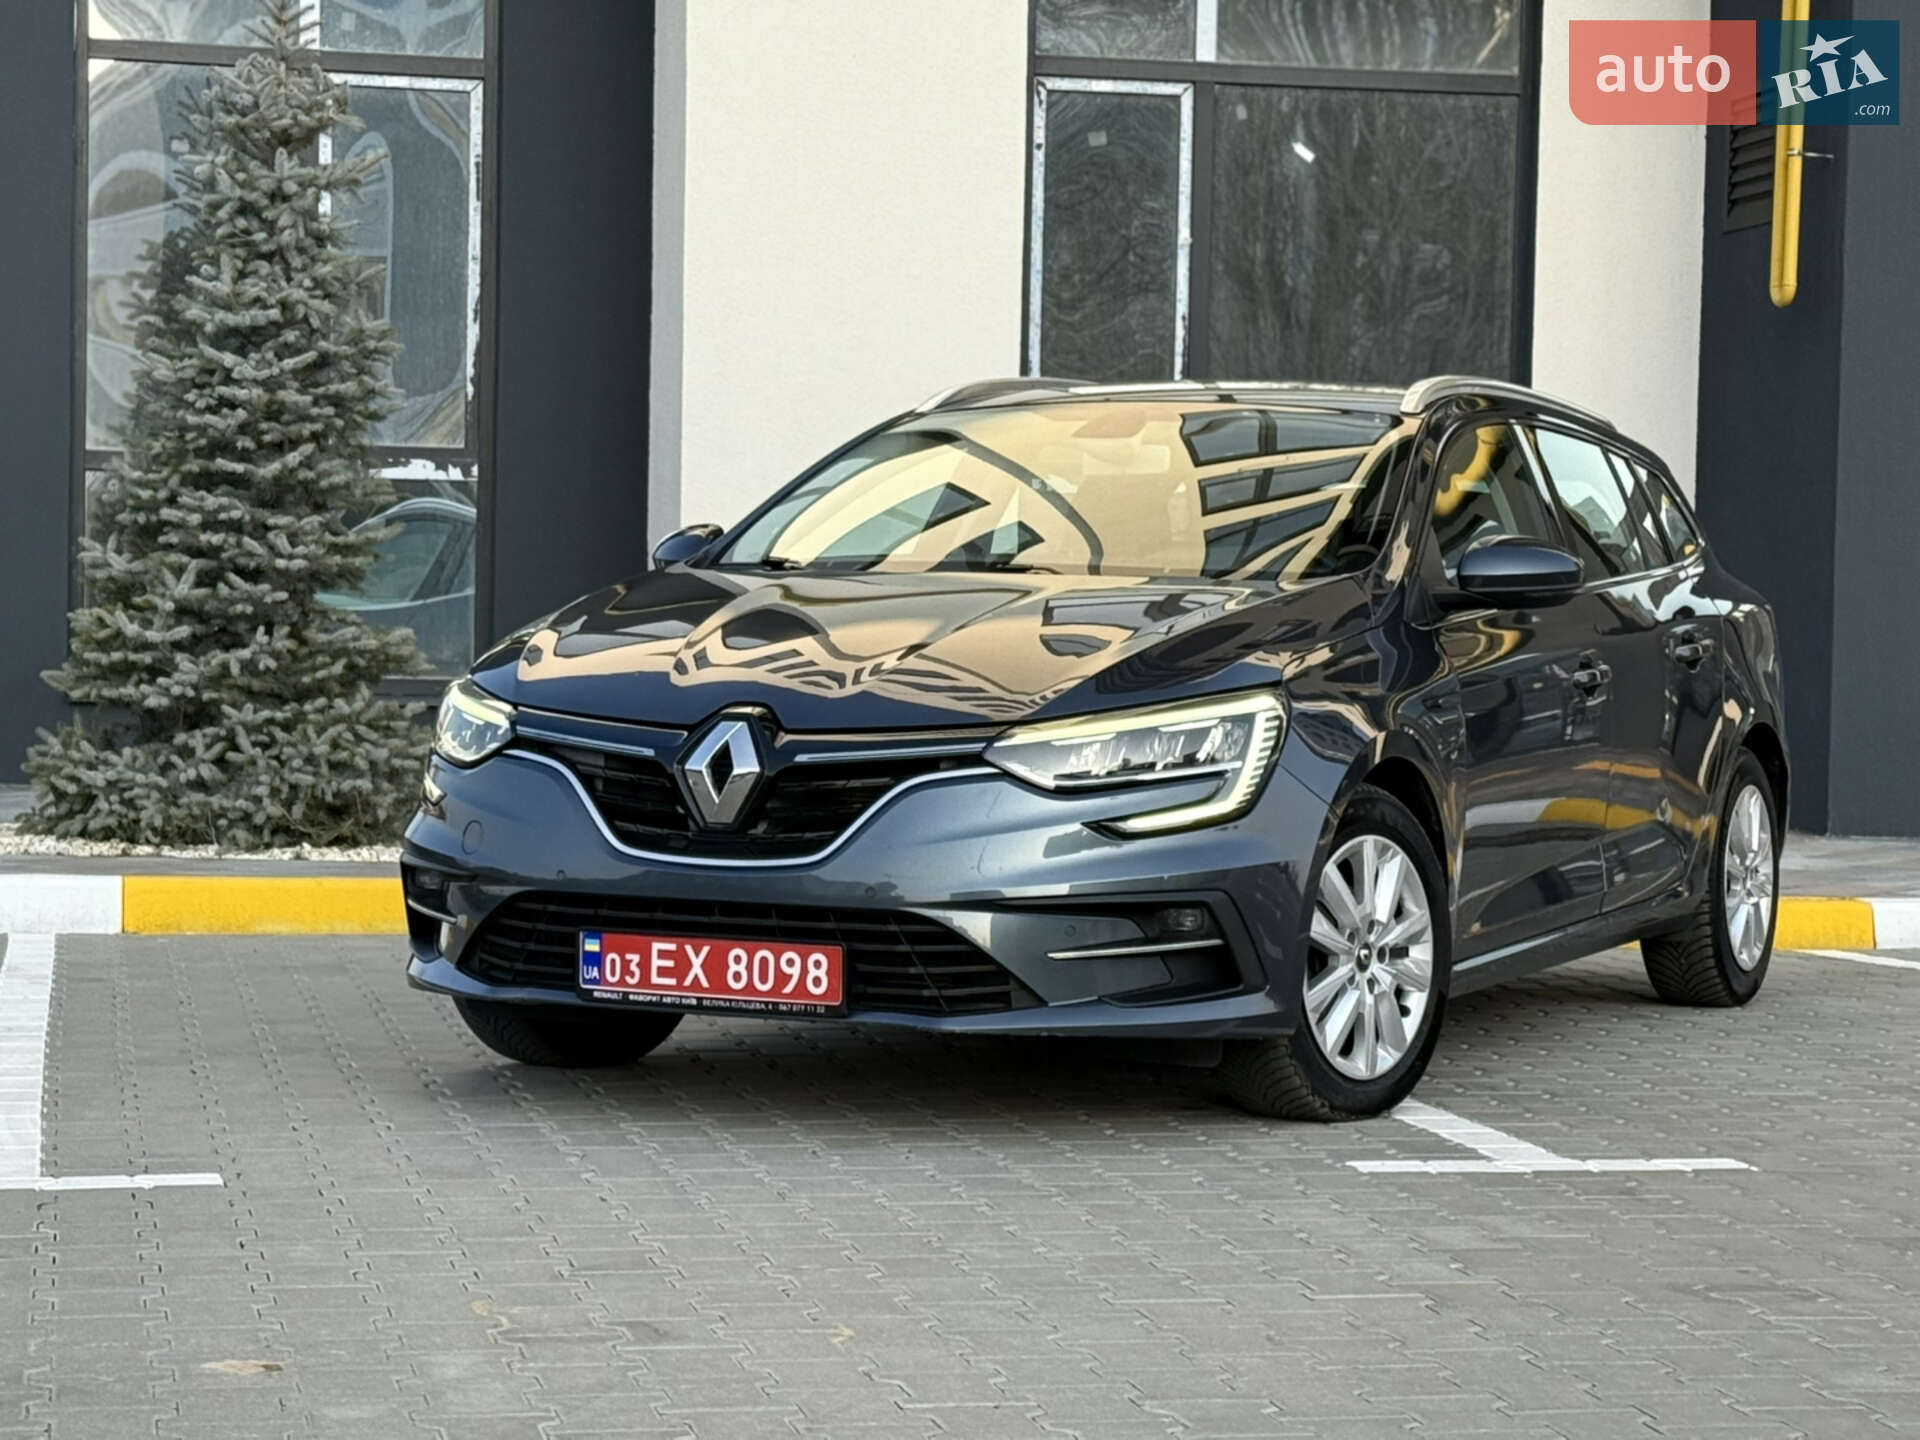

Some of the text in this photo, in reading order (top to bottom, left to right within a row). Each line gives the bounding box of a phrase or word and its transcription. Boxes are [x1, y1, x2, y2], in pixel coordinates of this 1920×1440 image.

[583, 965, 600, 979] UA
[605, 941, 829, 996] 03 EX 8098
[593, 991, 623, 1000] RENAULT
